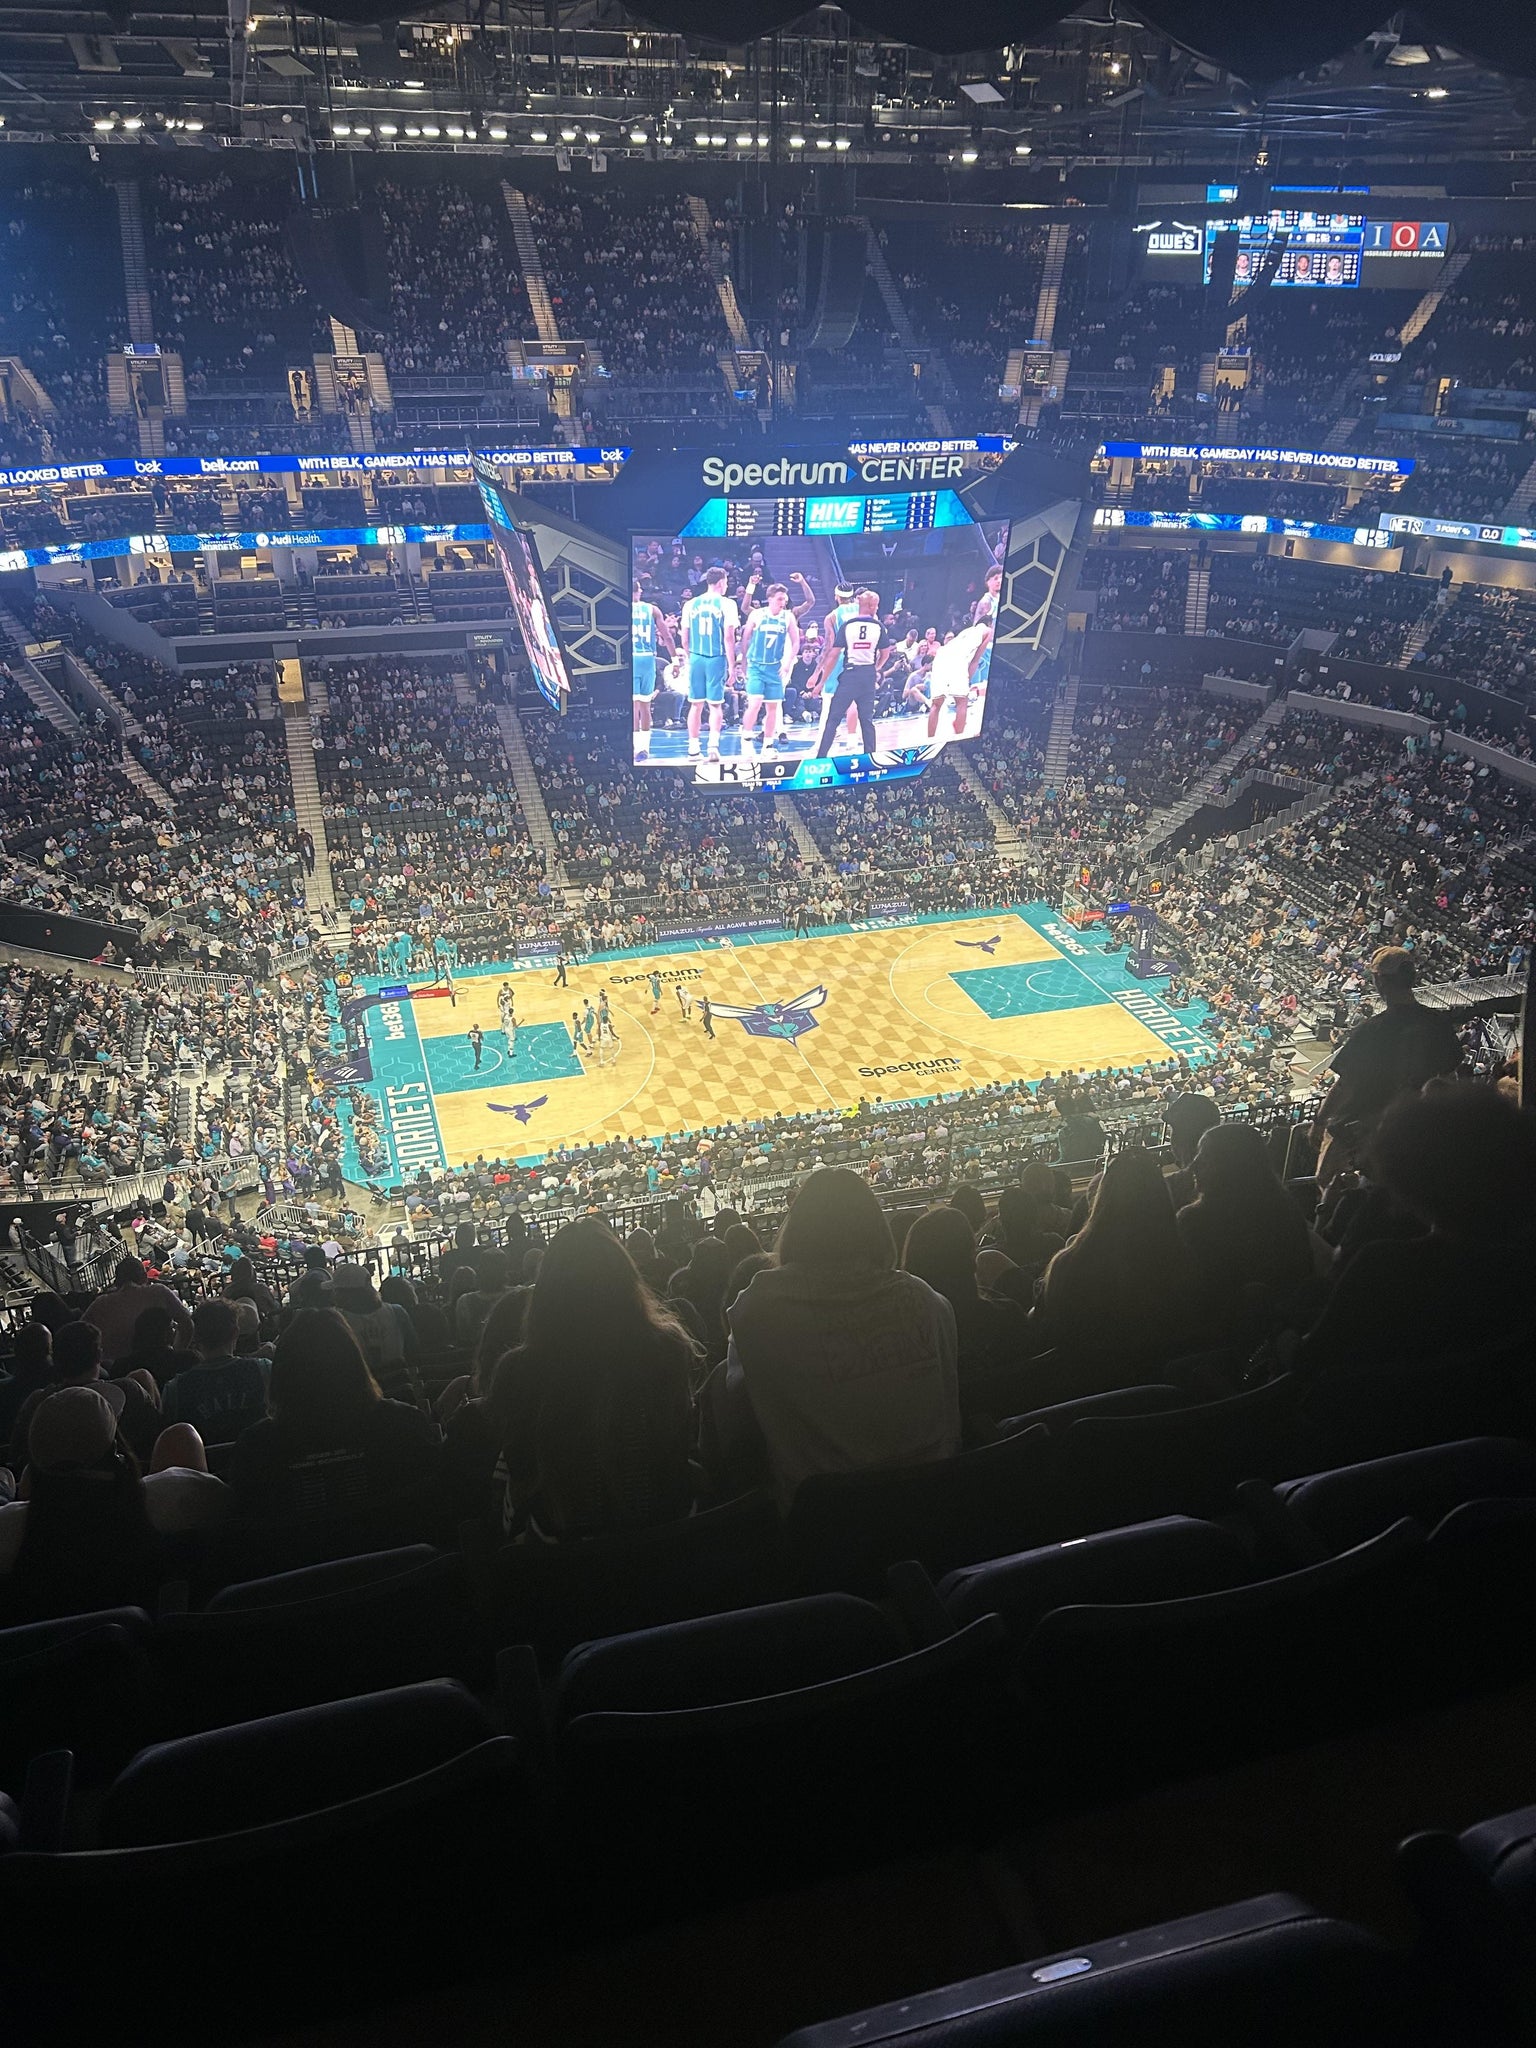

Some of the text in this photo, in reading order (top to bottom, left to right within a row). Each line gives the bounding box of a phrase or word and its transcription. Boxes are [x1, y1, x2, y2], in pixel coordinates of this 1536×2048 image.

[1148, 231, 1195, 250] OWE'S
[868, 442, 900, 453] NEVER
[901, 441, 940, 453] LOOKED
[941, 440, 979, 451] BETTER.
[200, 458, 259, 472] belk.com
[297, 458, 330, 470] WITH
[330, 457, 363, 470] BELK,
[363, 455, 421, 469] GAMEDAY
[422, 454, 447, 467] HAS
[533, 451, 576, 463] BETTER.
[1140, 445, 1400, 472] WITH BELK, GAMEDAY HAS NEVER LOOKED BETTER.
[9, 468, 59, 484] LOOKED
[60, 464, 107, 479] BETTER.
[702, 456, 964, 493] Spectrum CENTER
[810, 501, 862, 521] HIVE
[1390, 518, 1423, 534] NETS
[1435, 524, 1441, 532] 3
[1441, 525, 1463, 534] POINT
[1481, 527, 1500, 539] 0.0
[859, 625, 867, 640] 8
[766, 633, 777, 649] 7
[774, 765, 785, 777] 0
[803, 764, 832, 775] 10:27
[850, 759, 859, 770] 3
[871, 902, 908, 910] LUNAZUL
[659, 928, 695, 936] LUNAZUL
[1040, 922, 1090, 956] bet365
[518, 940, 560, 949] LUNAZUL
[660, 974, 702, 984] CENTER
[1111, 988, 1217, 1058] HORNETS
[858, 1057, 957, 1078] Spectrum
[916, 1065, 961, 1076] CENTER
[385, 1082, 443, 1174] HORNETS
